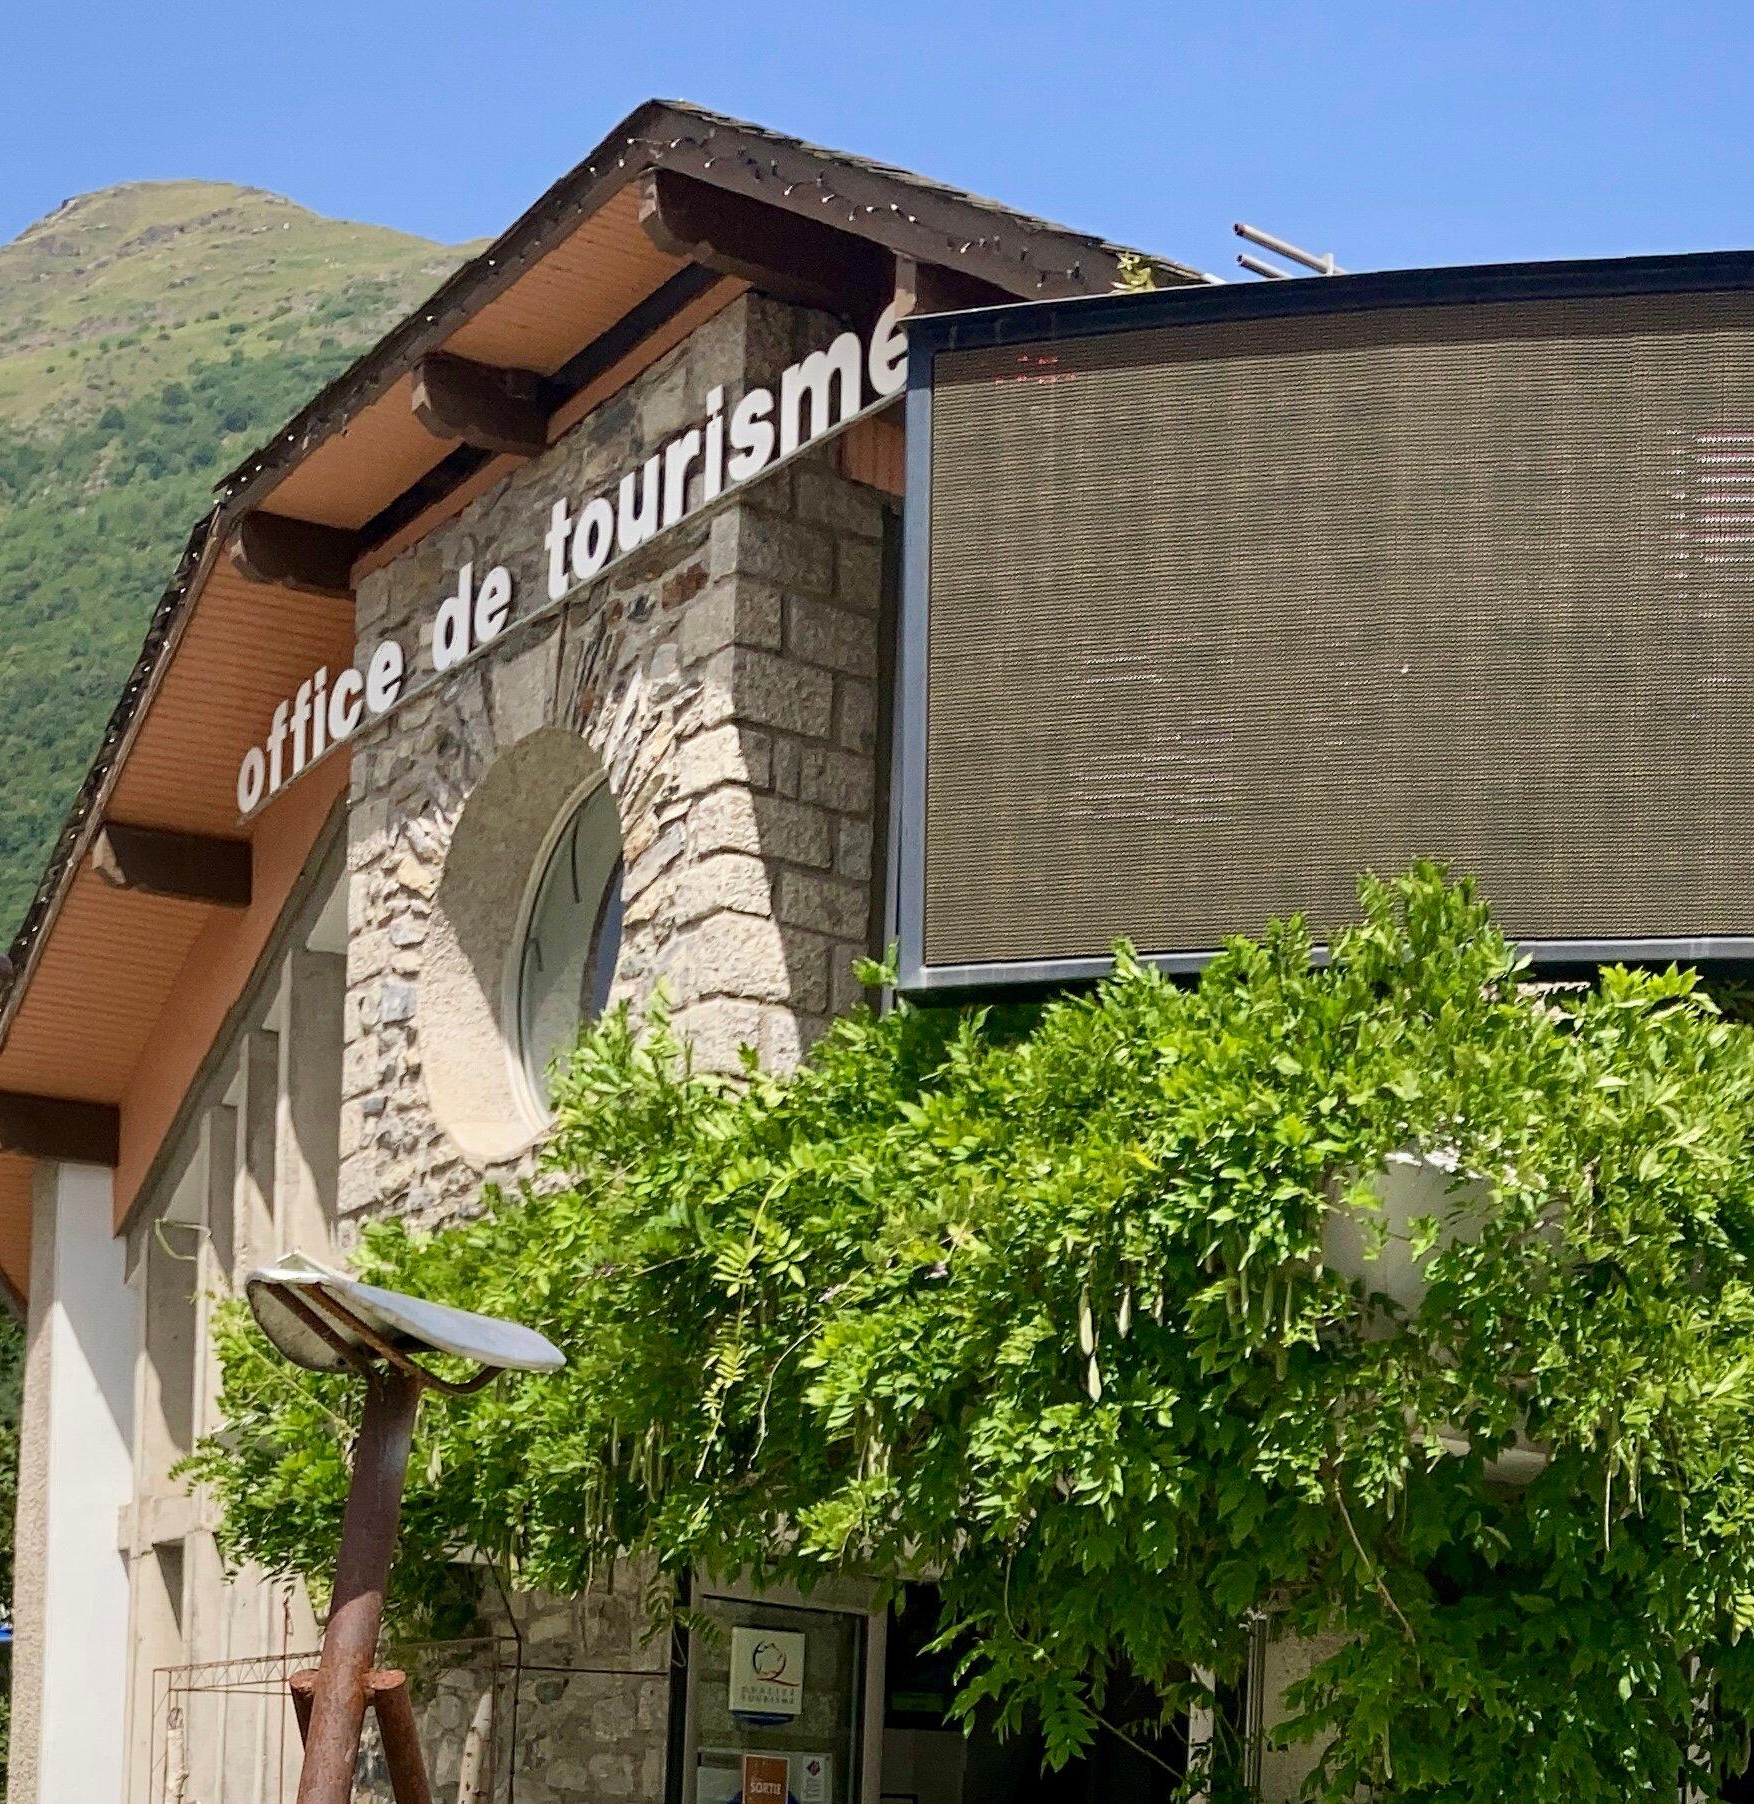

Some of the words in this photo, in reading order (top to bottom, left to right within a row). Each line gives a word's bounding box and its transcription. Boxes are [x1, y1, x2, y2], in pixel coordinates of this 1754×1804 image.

[238, 638, 404, 815] office
[432, 562, 512, 672] de
[544, 289, 915, 600] tourisme
